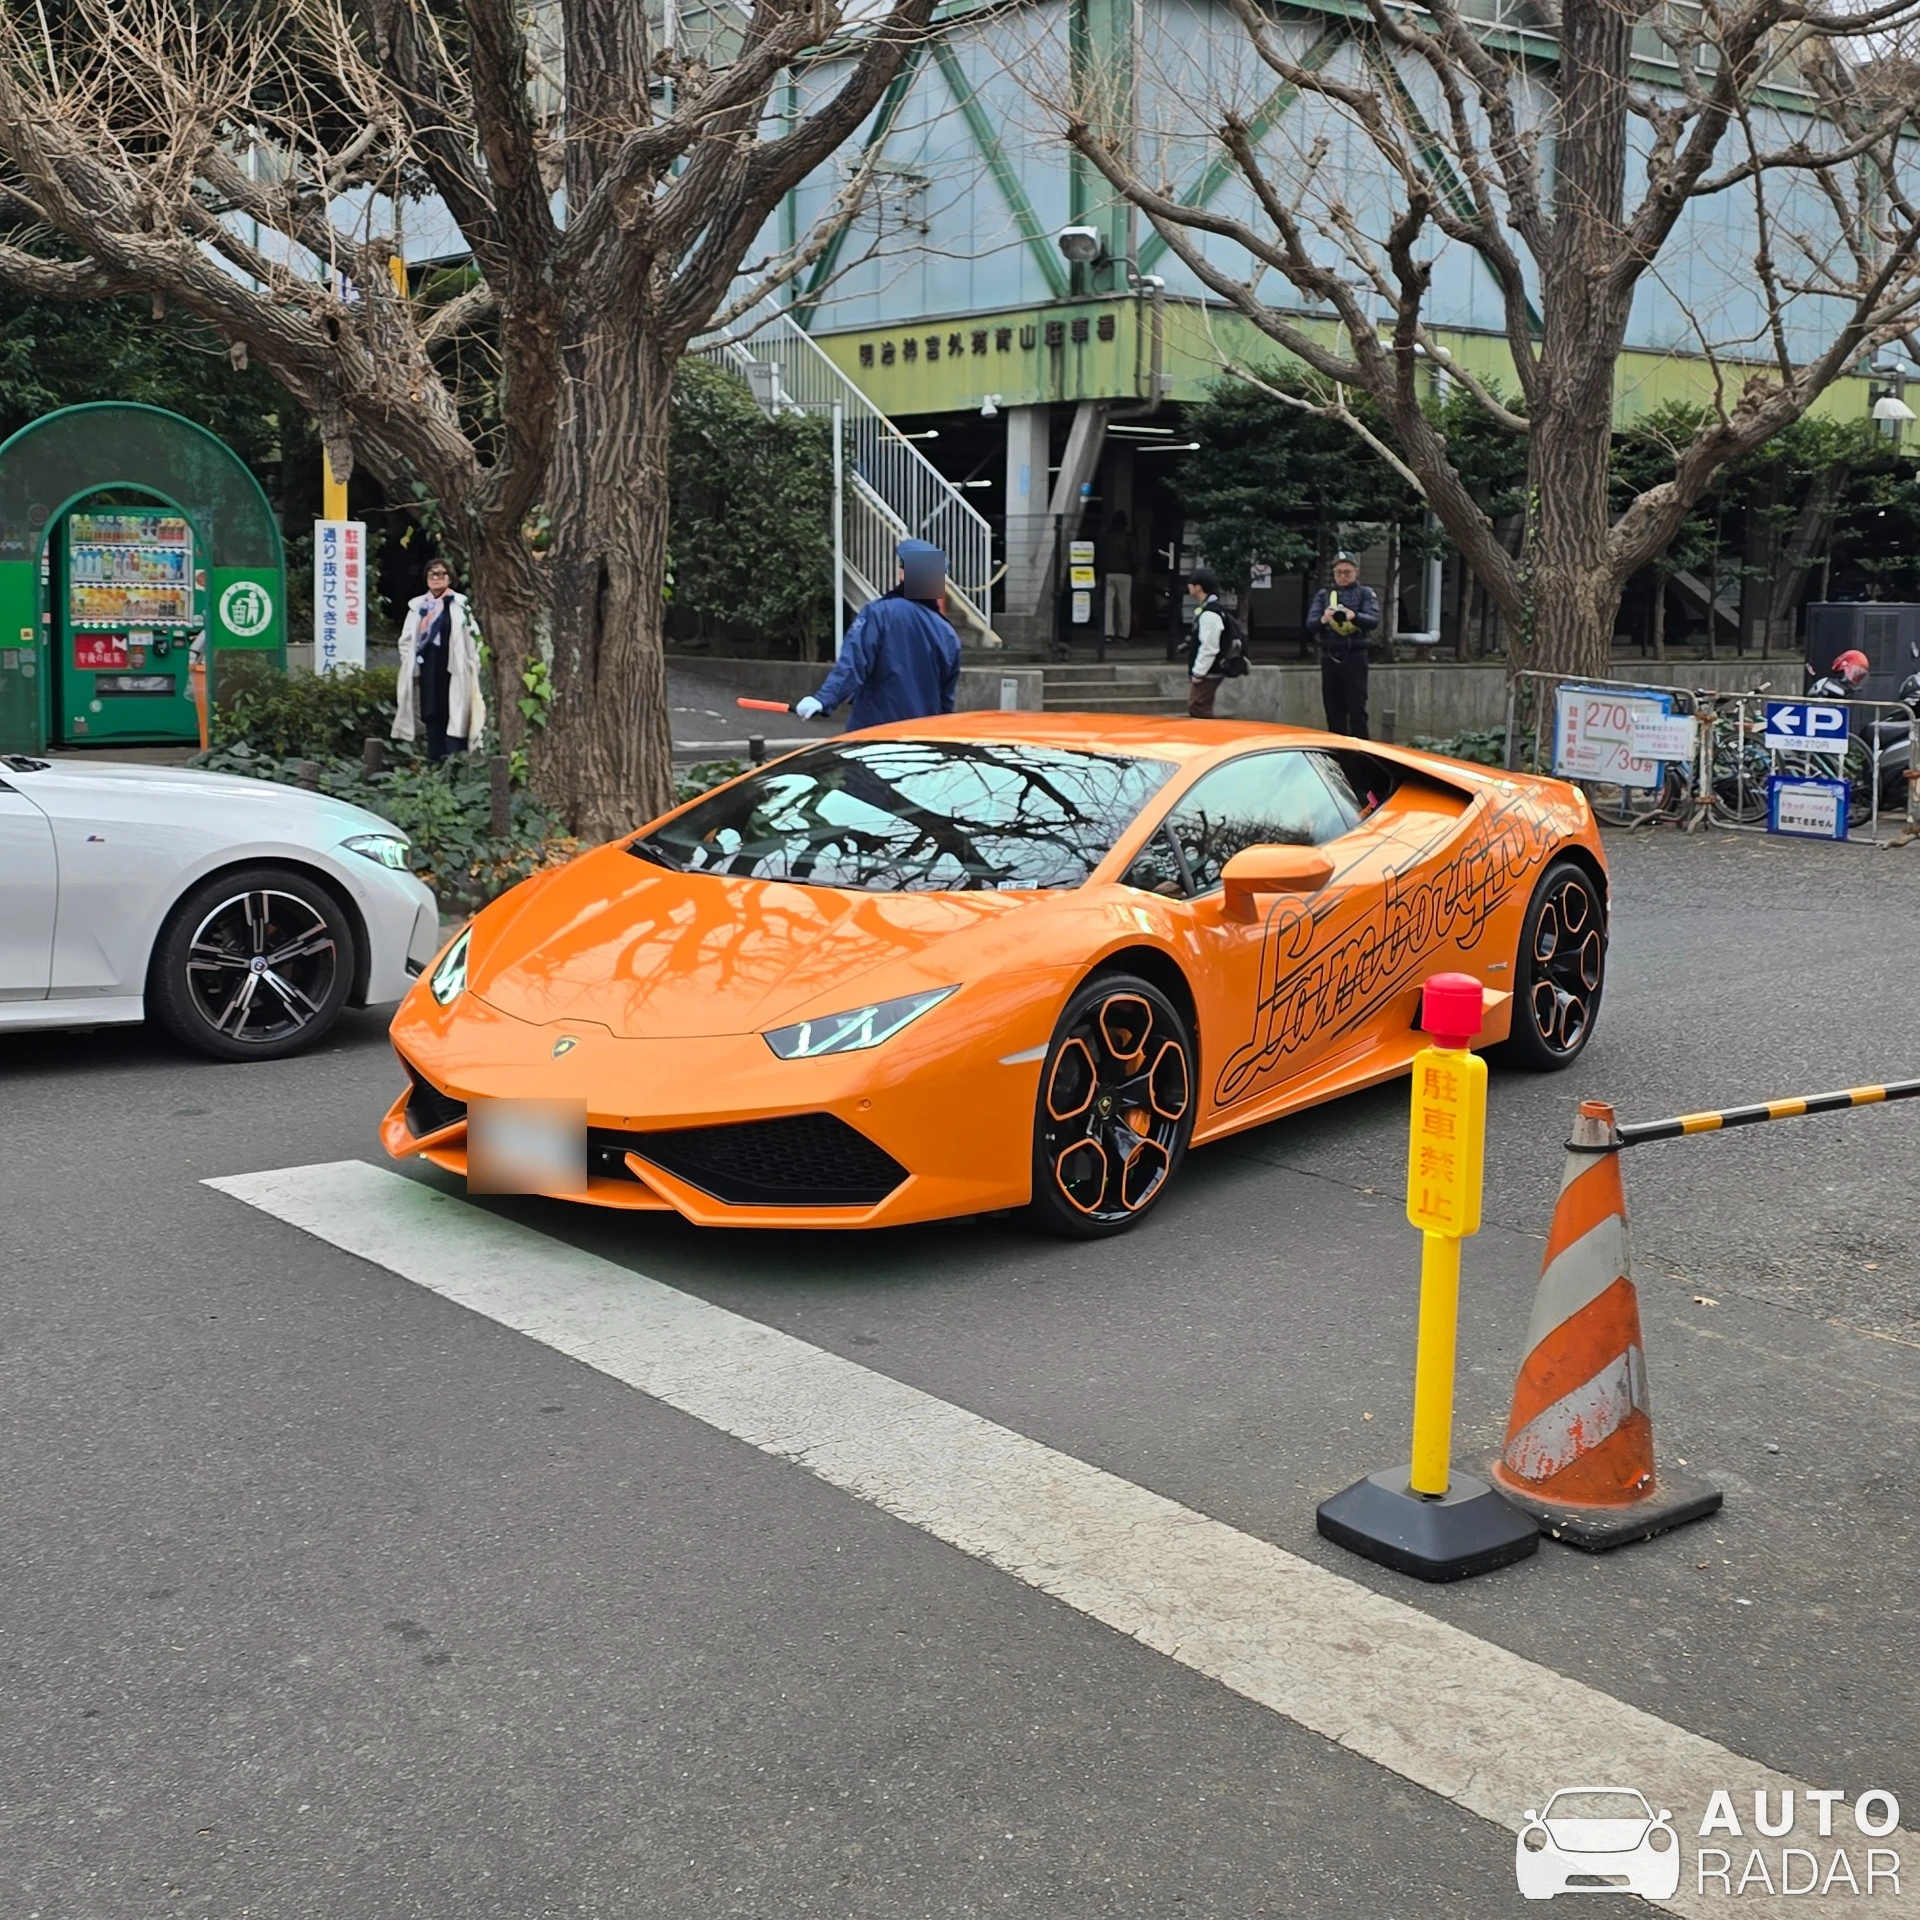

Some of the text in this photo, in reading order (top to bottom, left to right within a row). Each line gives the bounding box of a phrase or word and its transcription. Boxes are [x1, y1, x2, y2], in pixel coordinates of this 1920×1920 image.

[323, 528, 337, 674] 通り抜けできません
[345, 529, 359, 625] 駐車場につき
[1565, 706, 1578, 759] 駐車料金
[1806, 706, 1844, 737] P
[1418, 1067, 1457, 1222] 駐車禁止
